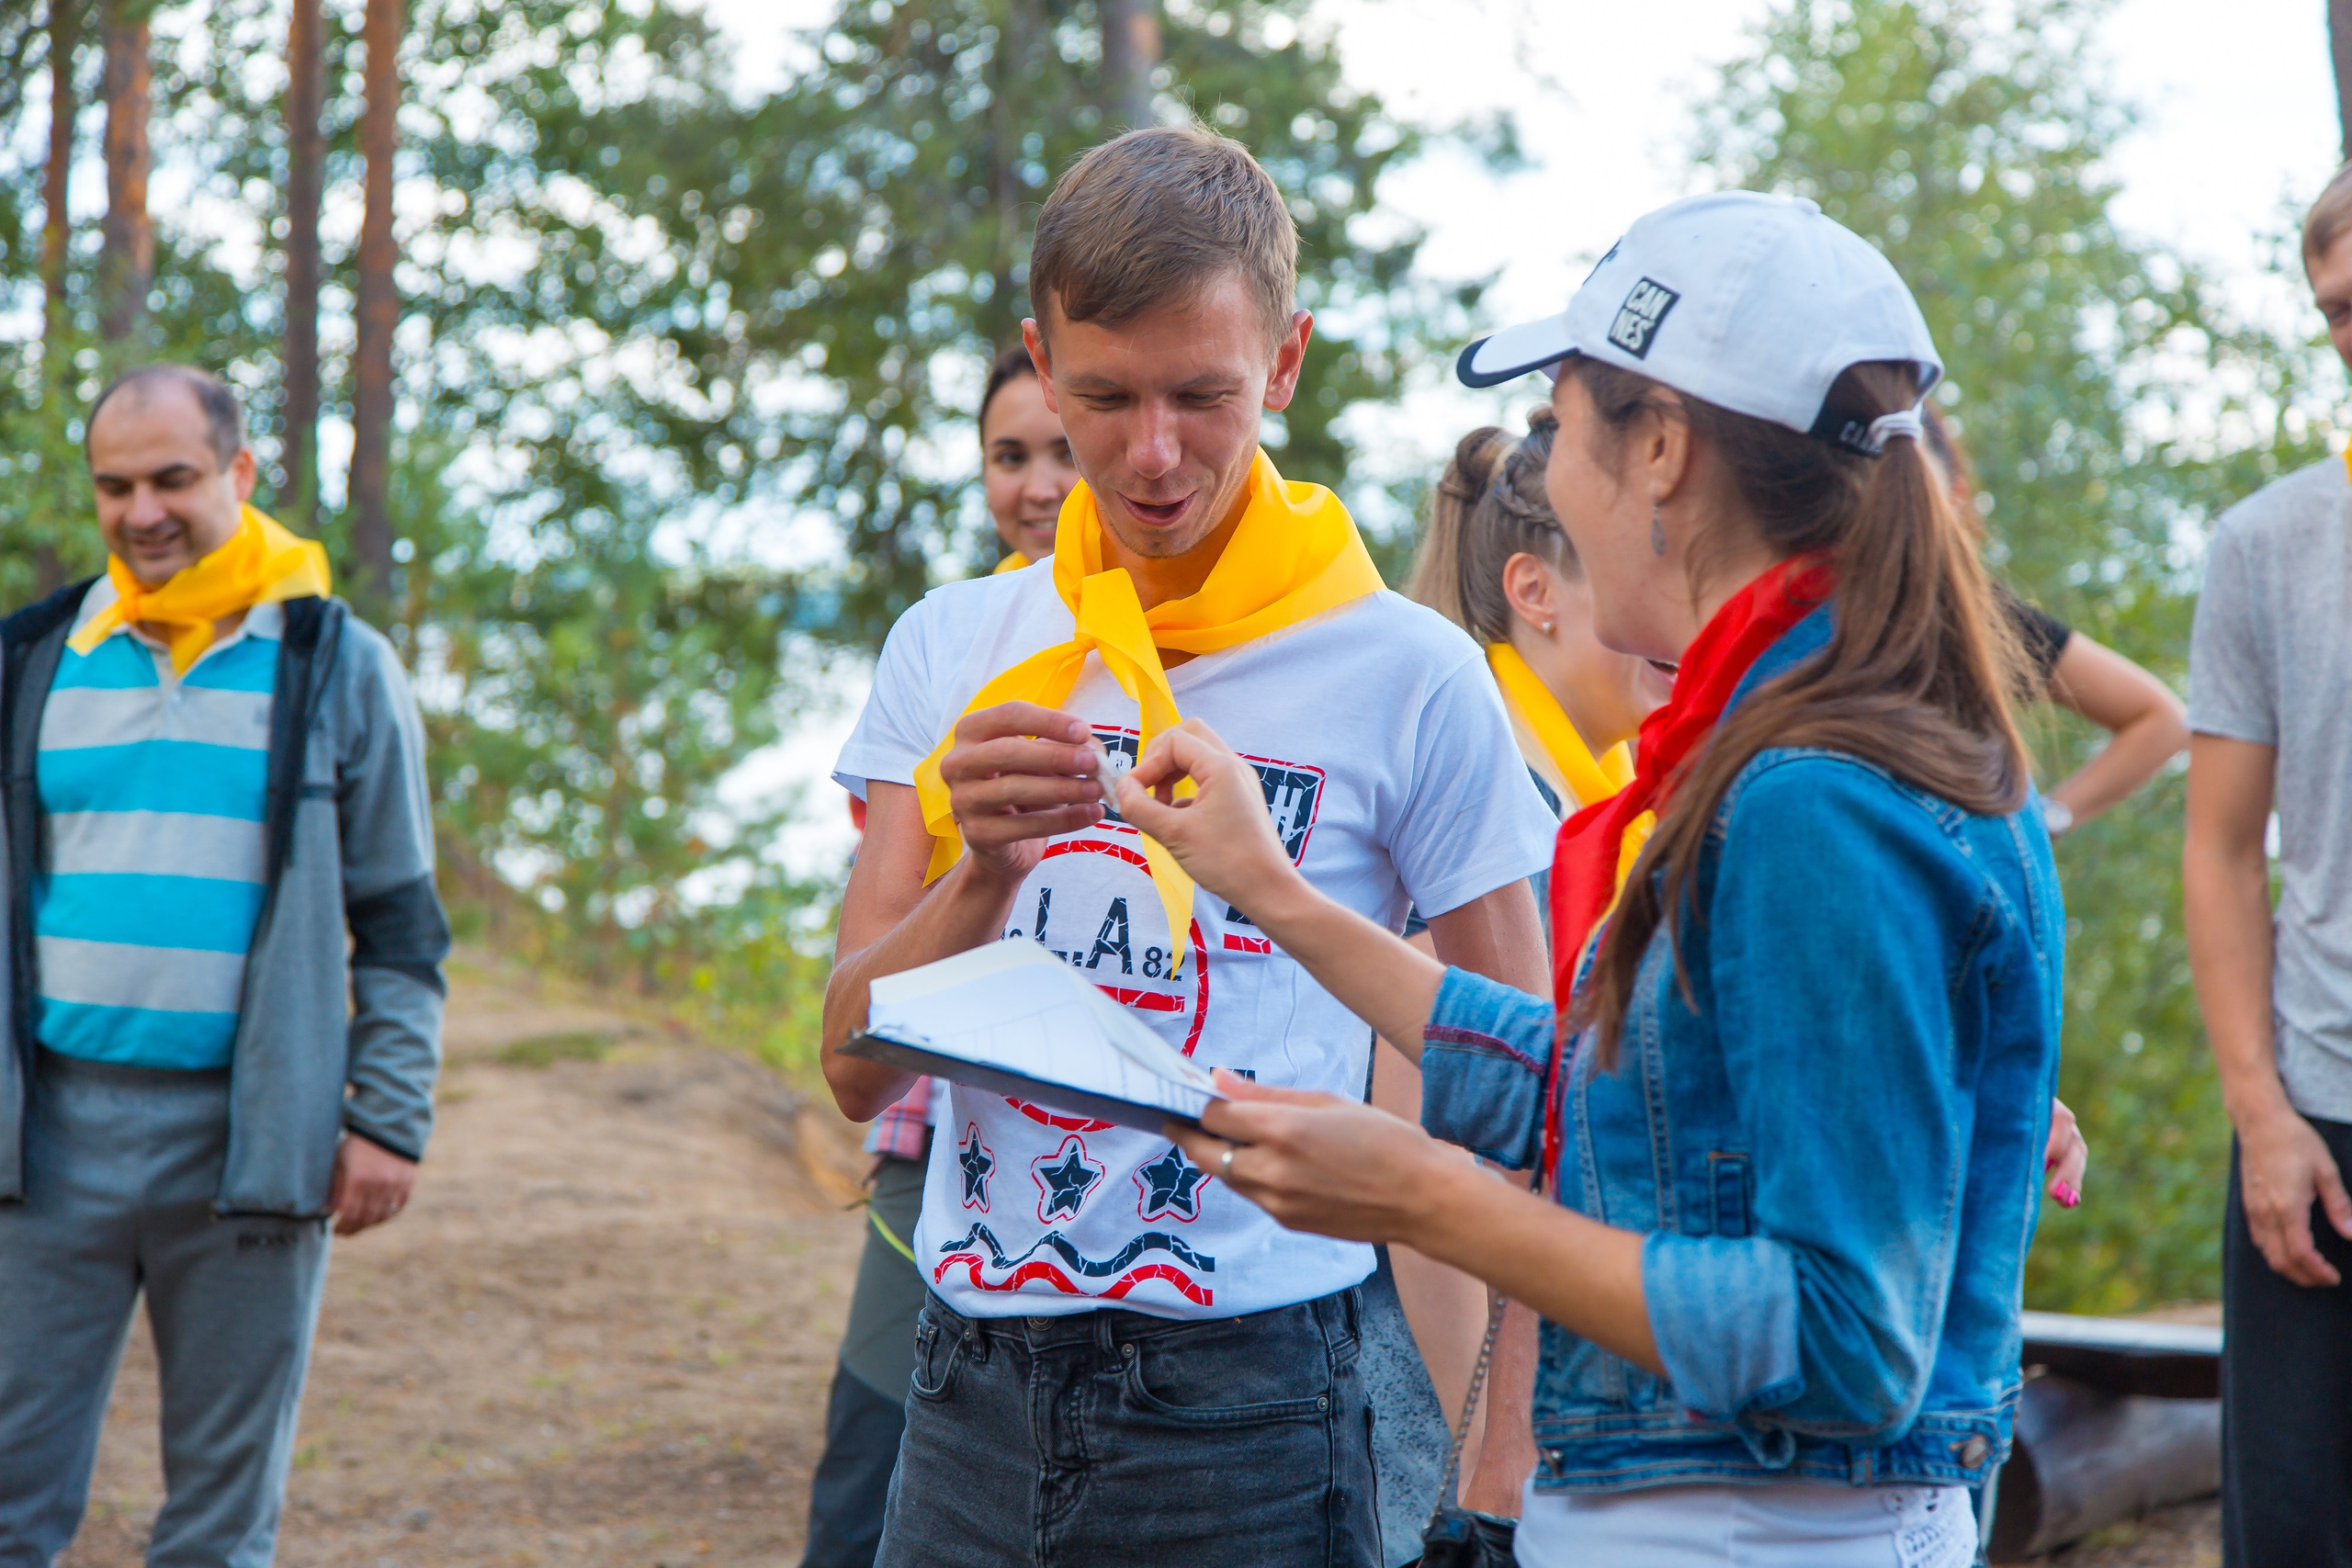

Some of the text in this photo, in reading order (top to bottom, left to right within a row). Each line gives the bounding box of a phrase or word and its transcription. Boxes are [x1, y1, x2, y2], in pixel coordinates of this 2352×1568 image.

[1624, 280, 1672, 320] CAN
[1610, 308, 1656, 349] NES
[1142, 946, 1185, 982] 82
